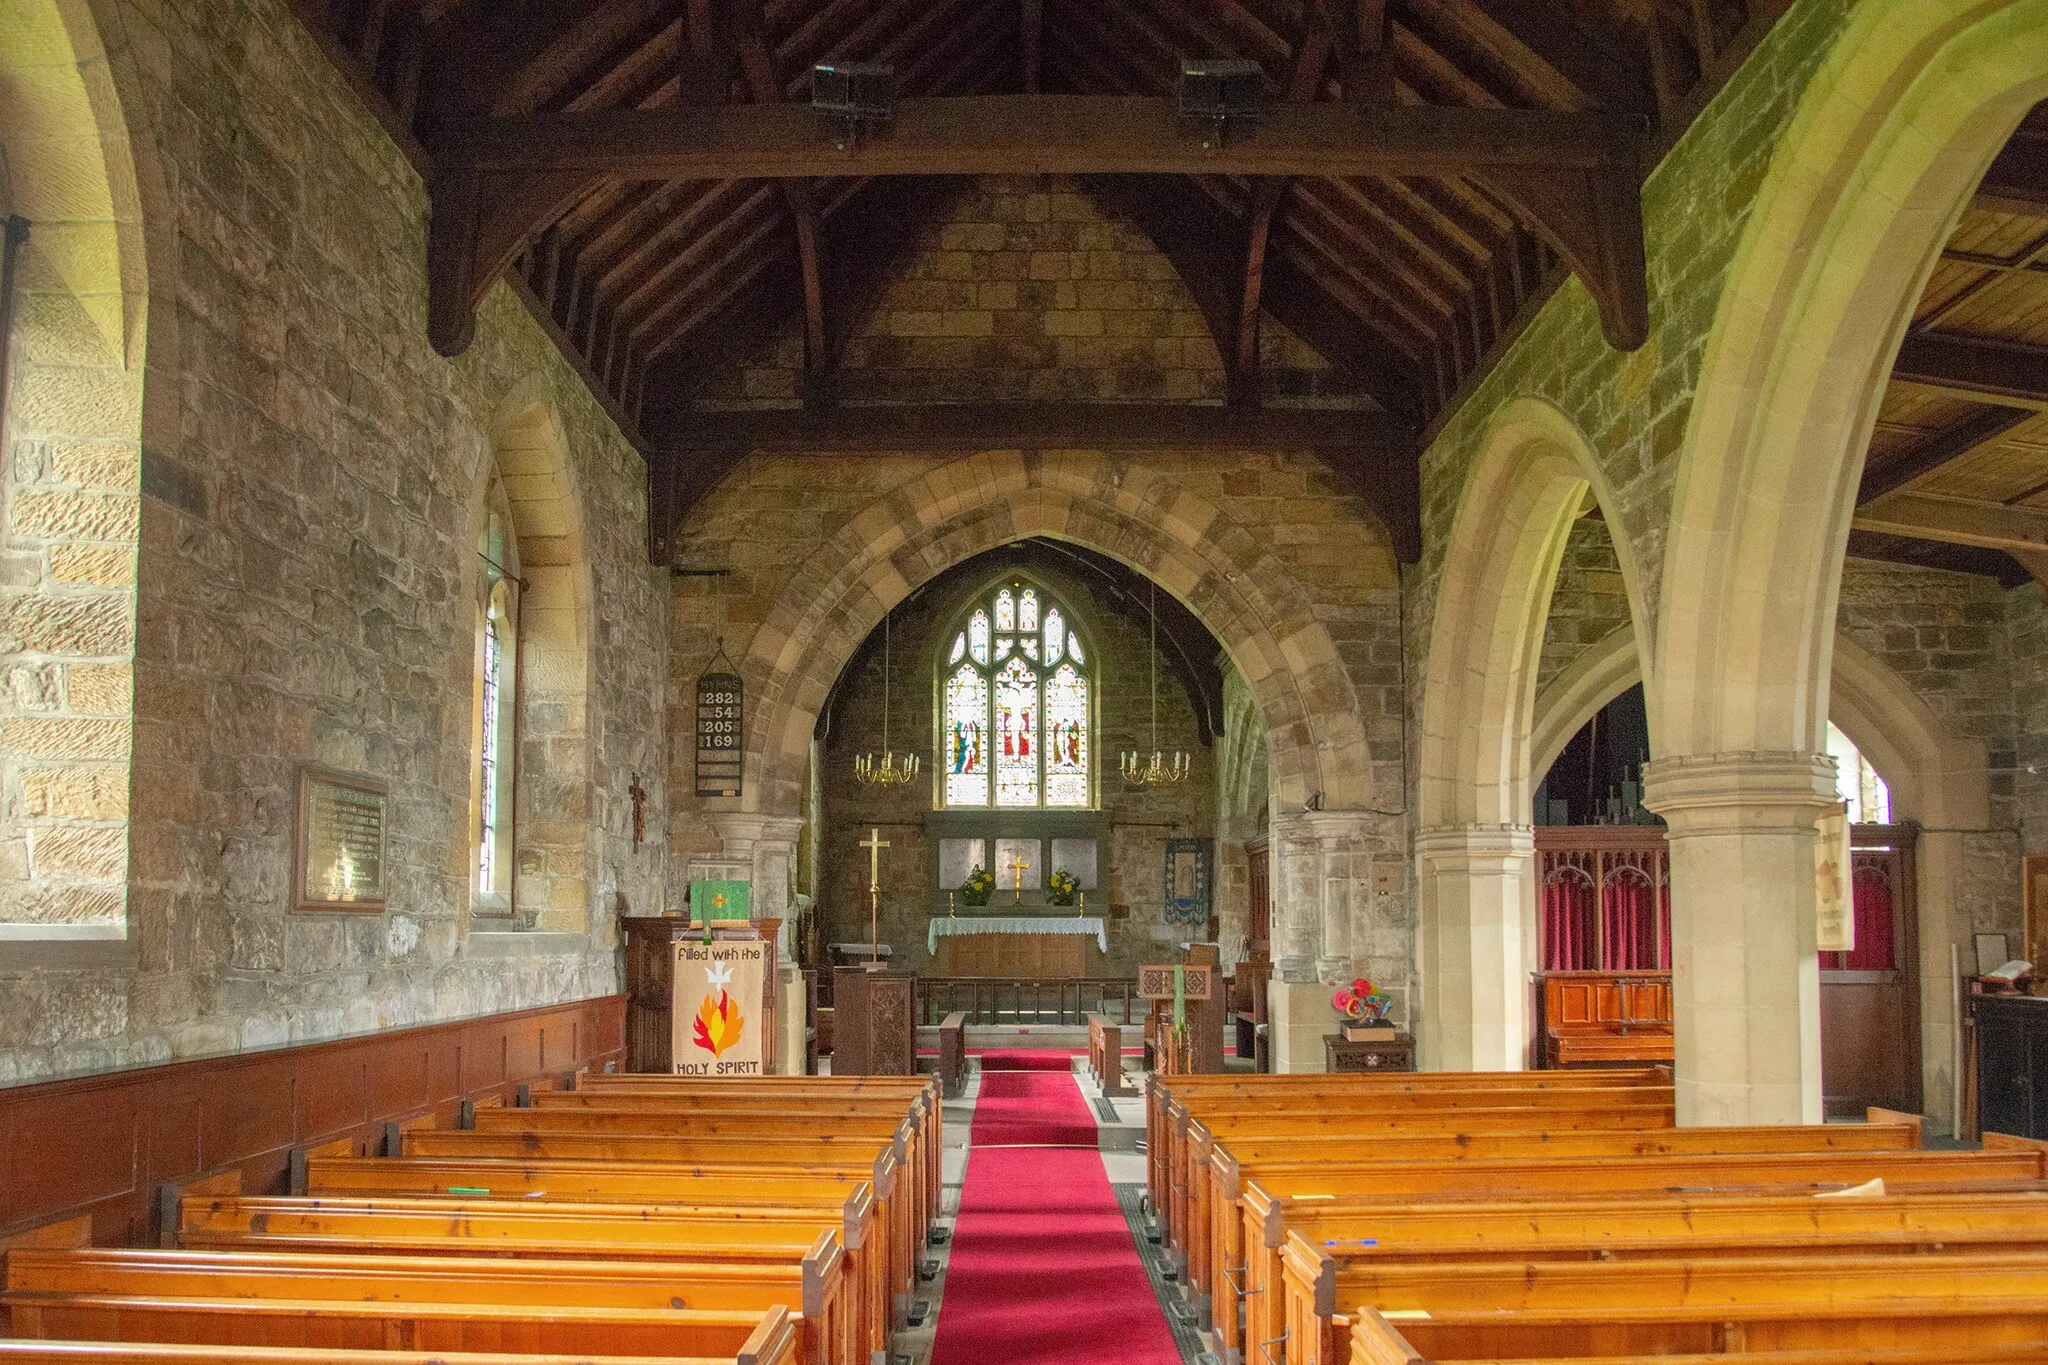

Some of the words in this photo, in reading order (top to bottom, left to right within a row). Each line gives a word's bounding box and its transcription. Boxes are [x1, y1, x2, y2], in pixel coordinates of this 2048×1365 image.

[705, 692, 733, 704] 282
[715, 707, 733, 719] 54
[705, 721, 733, 733] 205
[705, 735, 733, 747] 169
[678, 947, 709, 961] filled
[712, 947, 739, 961] with
[741, 947, 760, 960] the
[677, 1062, 709, 1075] HOLY
[716, 1061, 759, 1075] SPIRIT
